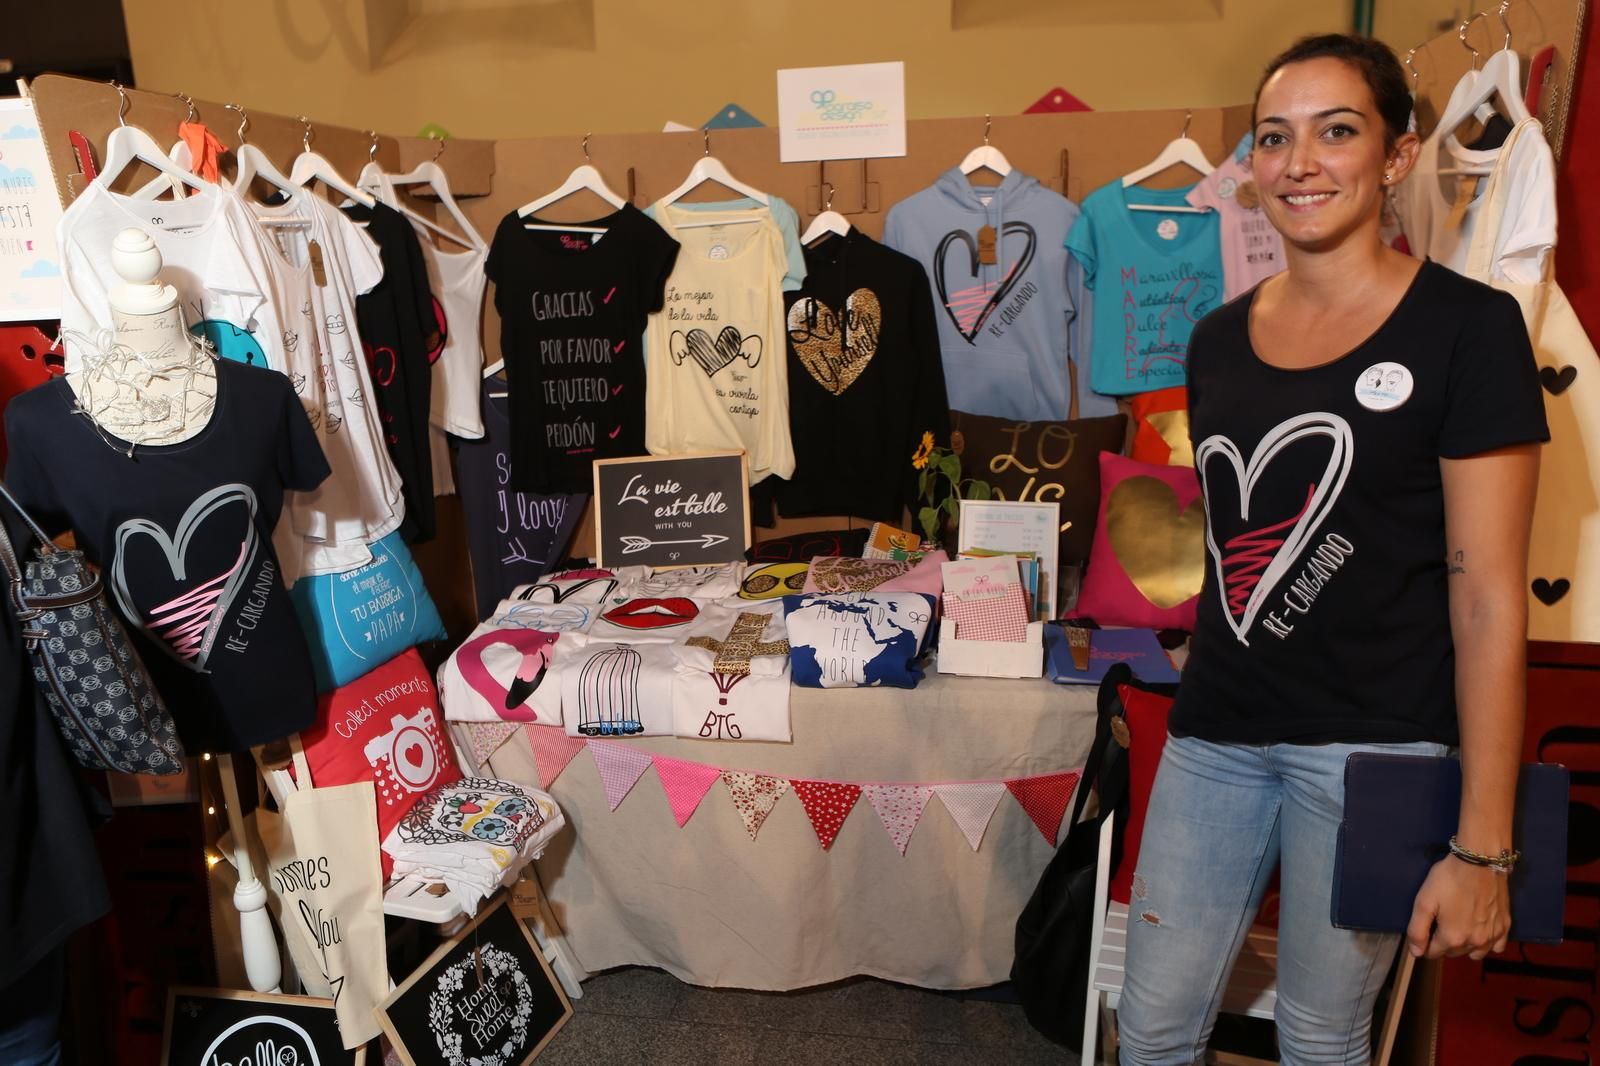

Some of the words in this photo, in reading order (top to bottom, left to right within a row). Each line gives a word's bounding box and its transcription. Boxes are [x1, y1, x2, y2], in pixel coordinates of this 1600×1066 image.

[532, 290, 594, 321] GRACIAS
[1124, 313, 1167, 334] Dulce
[540, 339, 564, 365] POR
[567, 338, 611, 364] FAVOR
[546, 415, 595, 448] PERDÓN
[618, 474, 650, 505] La
[654, 480, 682, 495] vie
[654, 498, 684, 518] est
[684, 491, 729, 516] belle
[1262, 533, 1354, 639] RE-CARGANDO
[225, 560, 275, 654] RE-CARGANDO
[350, 604, 368, 622] TU
[368, 586, 404, 615] BARRIGA
[371, 606, 402, 645] PAPÁ
[832, 627, 864, 653] THE
[335, 699, 378, 738] Collect
[374, 676, 428, 707] moments
[465, 988, 505, 1037] Sweet
[473, 1006, 514, 1051] Home
